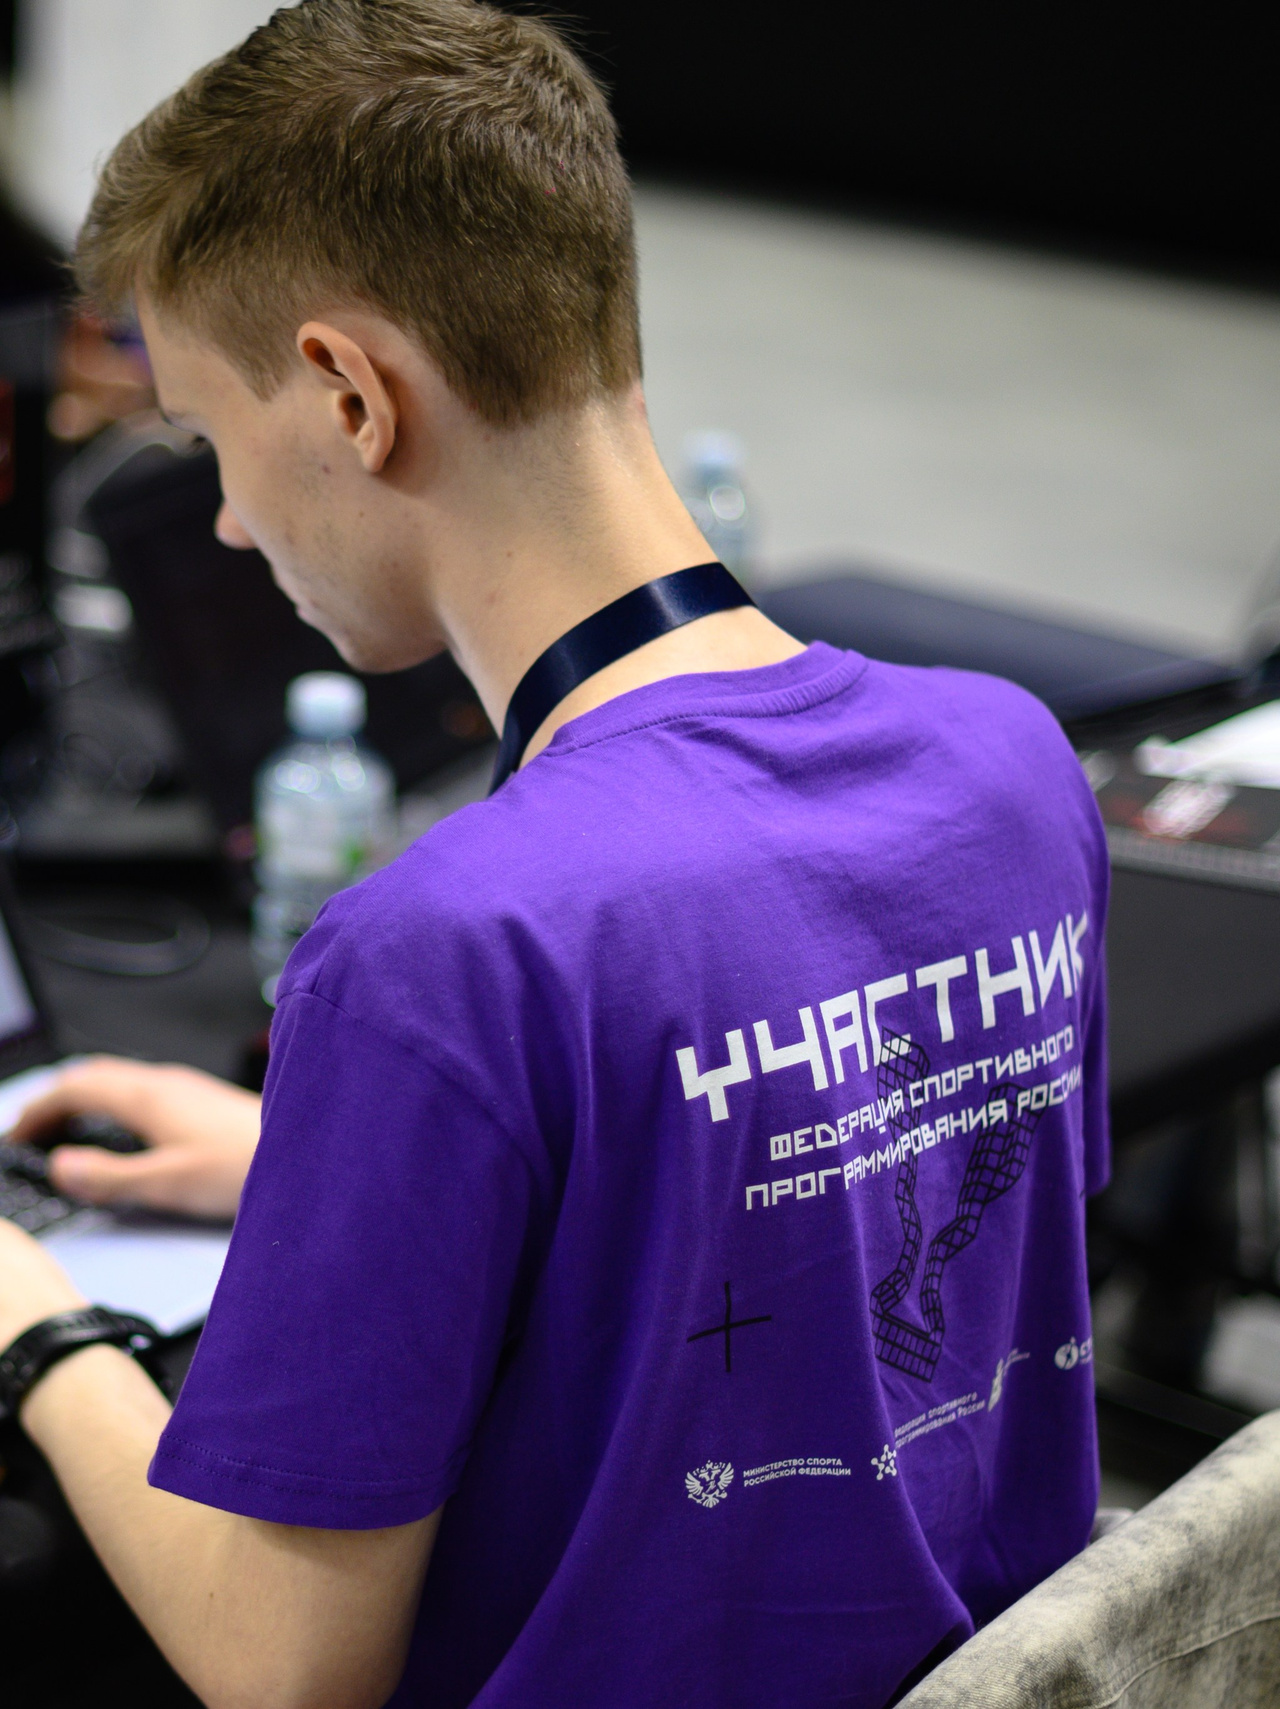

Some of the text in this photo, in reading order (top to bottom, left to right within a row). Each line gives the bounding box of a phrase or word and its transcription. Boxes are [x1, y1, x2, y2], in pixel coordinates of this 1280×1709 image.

[676, 911, 1088, 1123] УЧАСТНИК
[745, 1062, 1082, 1211] ПРОГРАММИРОВАНИЯ РОССИИ
[770, 1025, 1074, 1162] ФЕДЕРАЦИЯ СПОРТИВНОГО
[742, 1457, 843, 1478] МИНИСТЕРСТВО СПОРТА
[743, 1466, 852, 1488] РОССИЙСКОЙ ФЕДЕРАЦИИ
